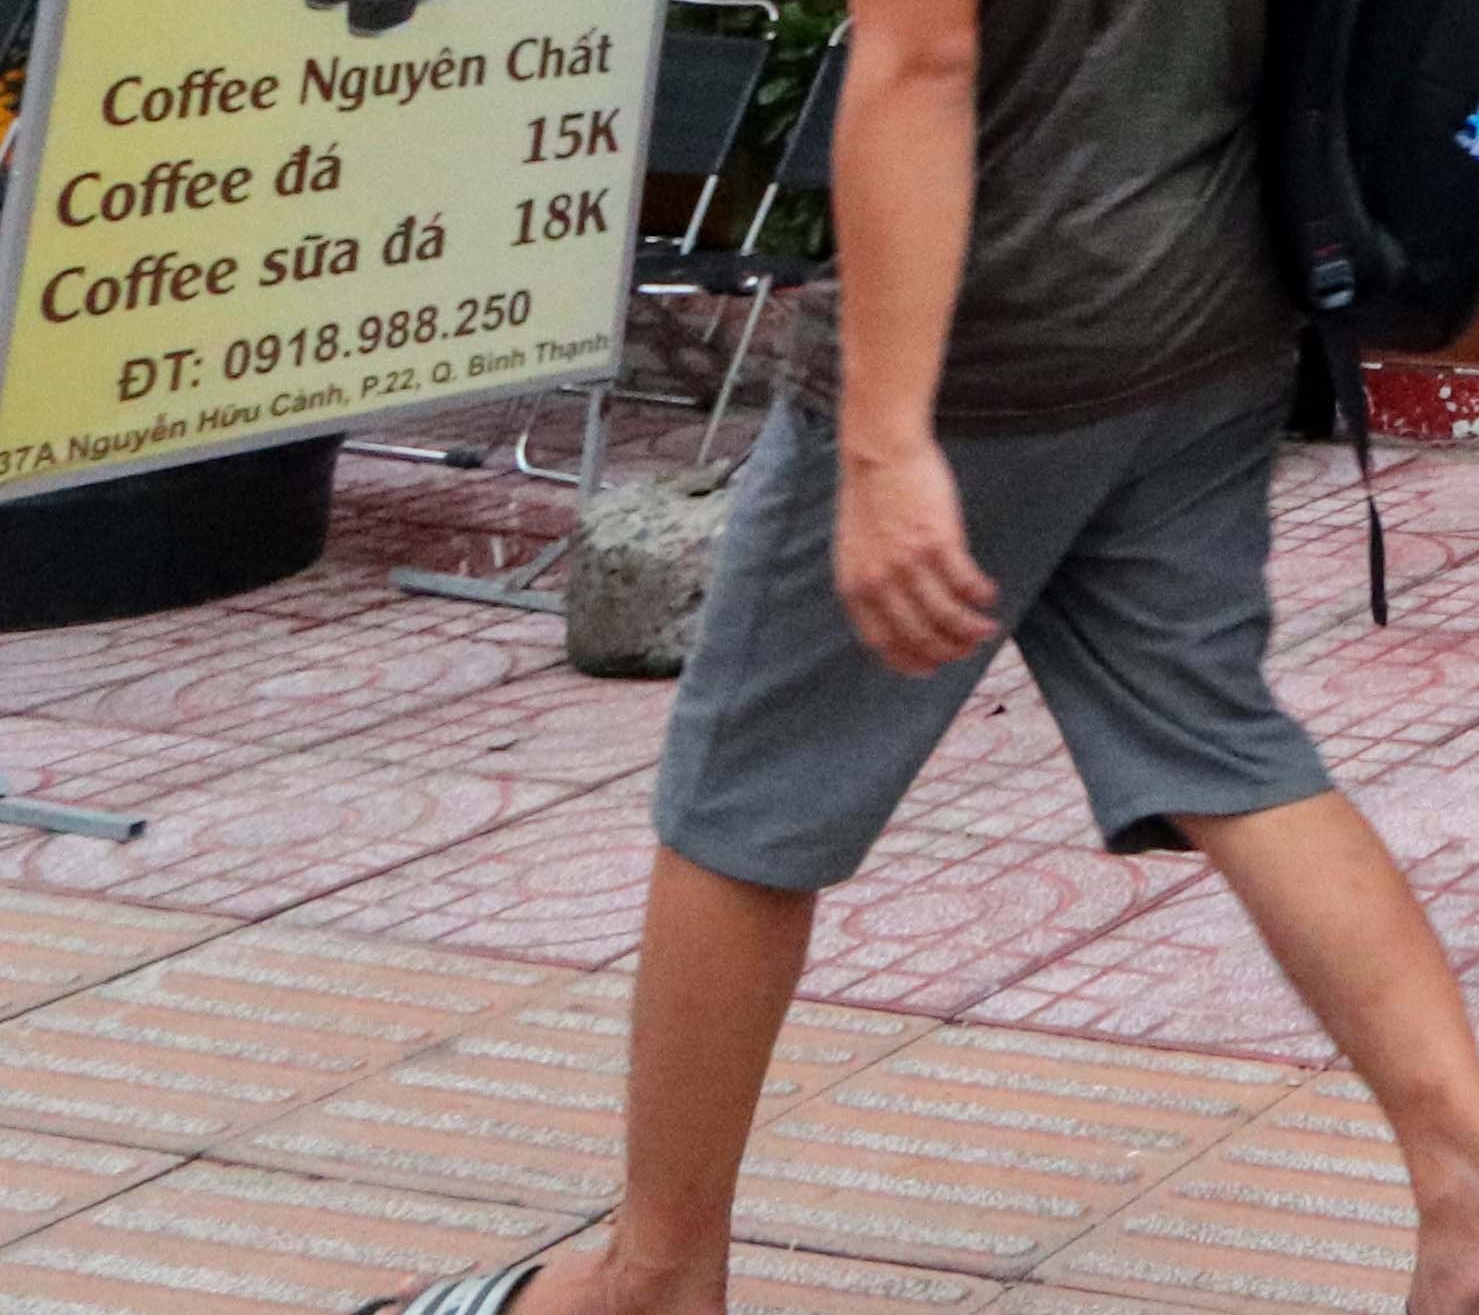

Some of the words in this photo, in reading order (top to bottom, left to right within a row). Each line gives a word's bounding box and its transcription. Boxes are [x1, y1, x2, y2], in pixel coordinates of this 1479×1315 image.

[102, 69, 279, 128] Coffee
[298, 48, 487, 113] Nguyên
[506, 28, 612, 82] Chất
[57, 159, 253, 229] Coffee
[275, 143, 343, 196] đá
[522, 109, 620, 163] 15K
[40, 254, 237, 324] Coffee
[258, 234, 360, 286] sữa
[383, 212, 445, 263] đá
[511, 188, 610, 247] 18K
[67, 415, 188, 461] Nguyễn
[432, 361, 455, 384] Q.
[535, 333, 610, 365] Thạnh
[118, 349, 203, 402] ĐT:
[223, 289, 531, 380] 0918.988.250
